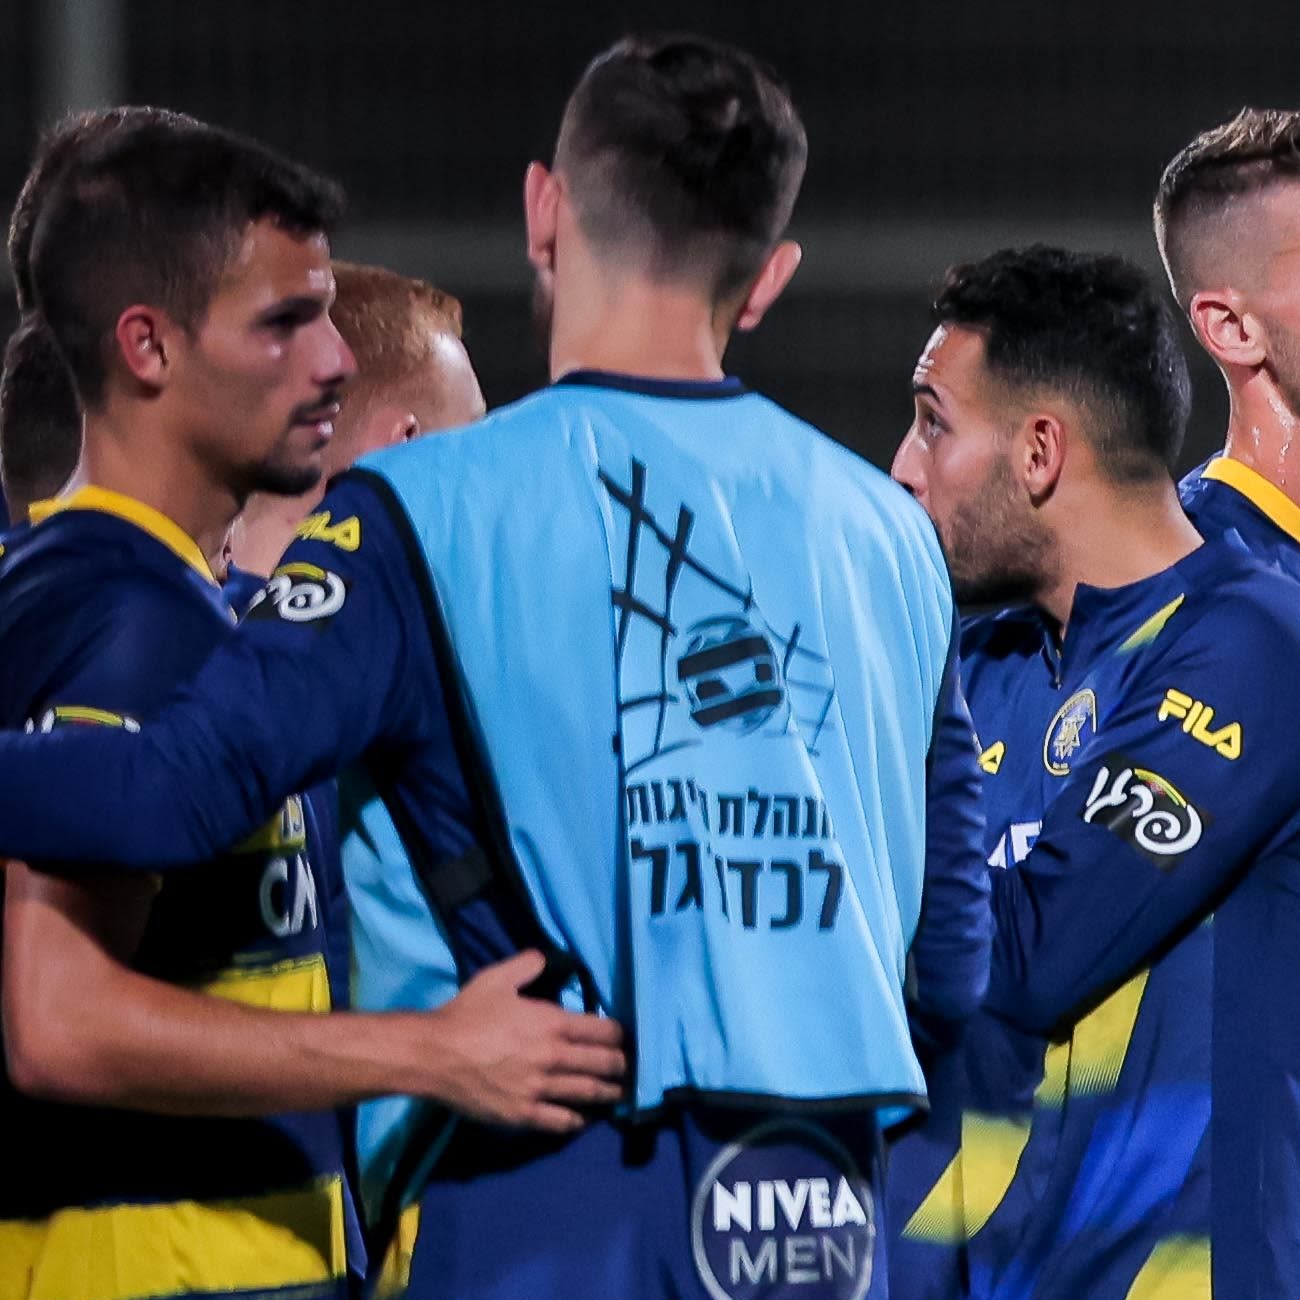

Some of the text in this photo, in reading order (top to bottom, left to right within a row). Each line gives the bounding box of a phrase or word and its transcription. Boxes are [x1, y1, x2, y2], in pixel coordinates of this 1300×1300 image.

[1158, 688, 1242, 760] FILA
[713, 1175, 867, 1232] NIVEA
[729, 1234, 857, 1285] MEN
